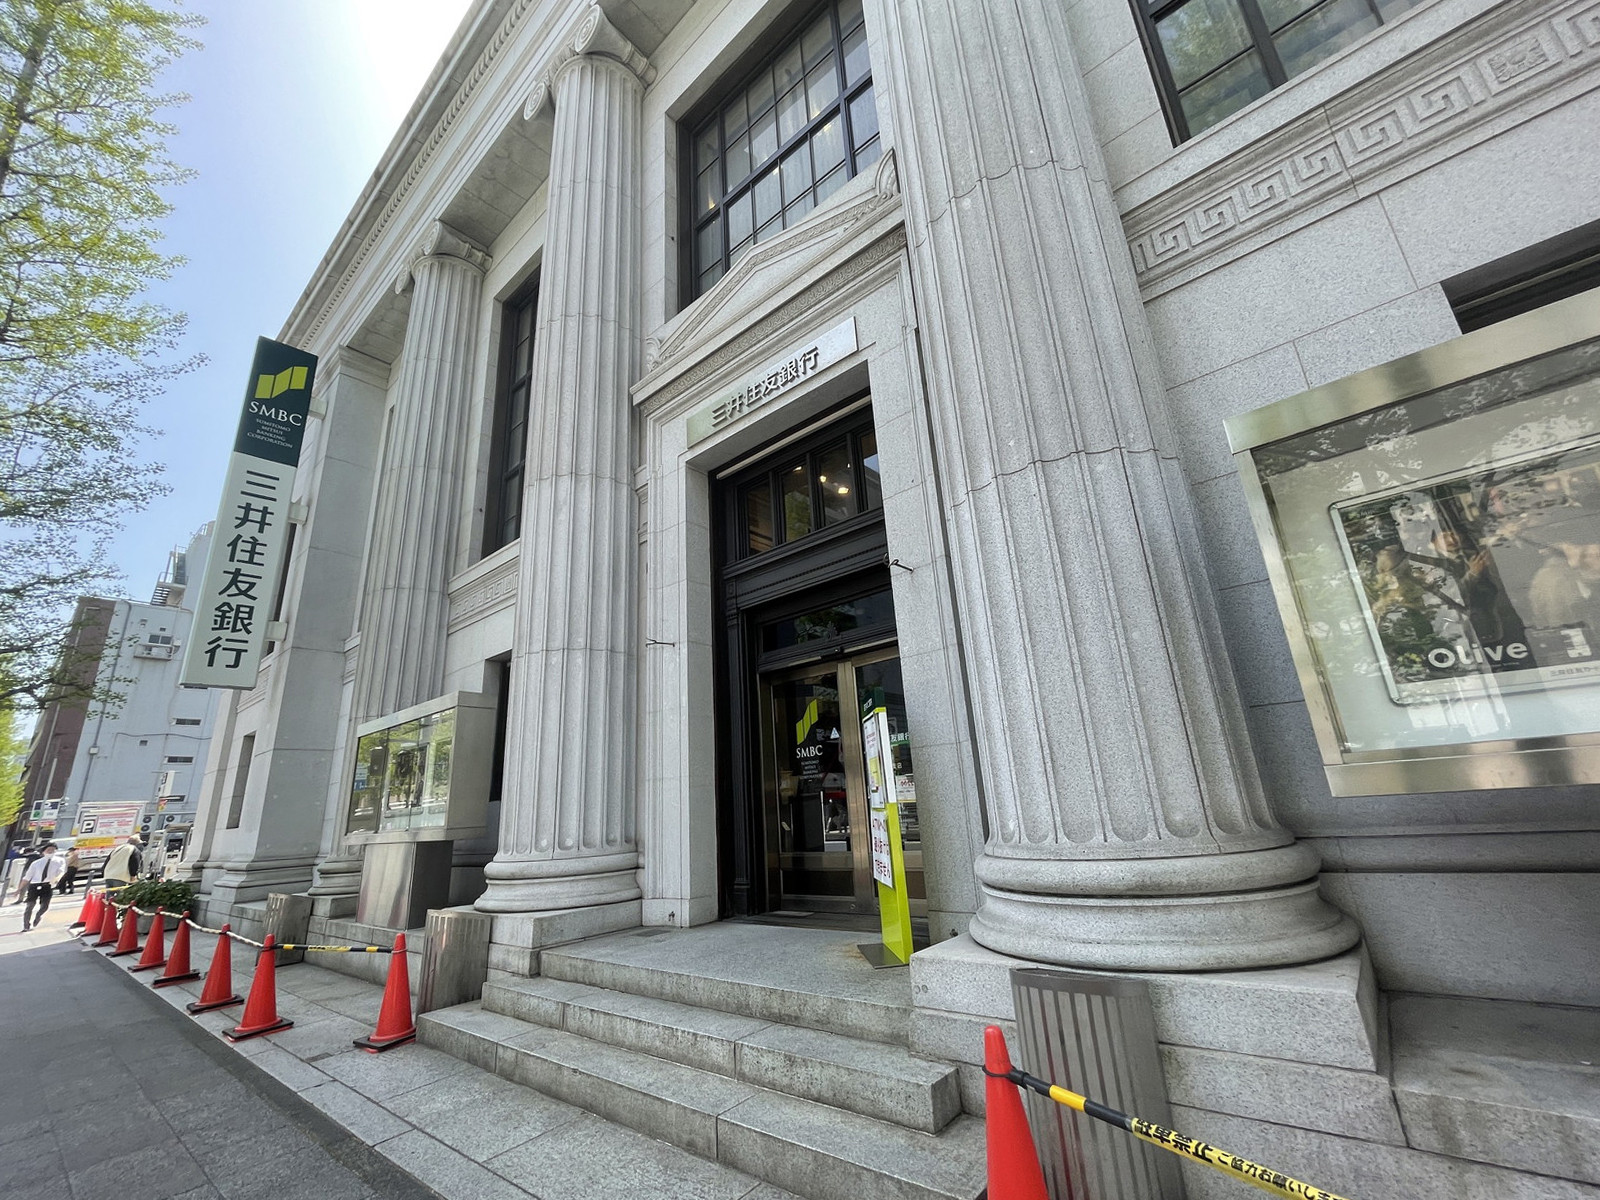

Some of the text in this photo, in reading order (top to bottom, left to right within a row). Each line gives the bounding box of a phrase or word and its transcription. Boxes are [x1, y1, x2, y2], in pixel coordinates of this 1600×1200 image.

[248, 401, 302, 426] SMBC
[711, 346, 819, 428] 三井住友銀行
[204, 470, 280, 669] 三井住友銀行
[1428, 642, 1529, 669] Olive
[796, 744, 824, 759] SMBC
[1134, 1119, 1343, 1200] 駐車禁止 ご協力お願いしま
